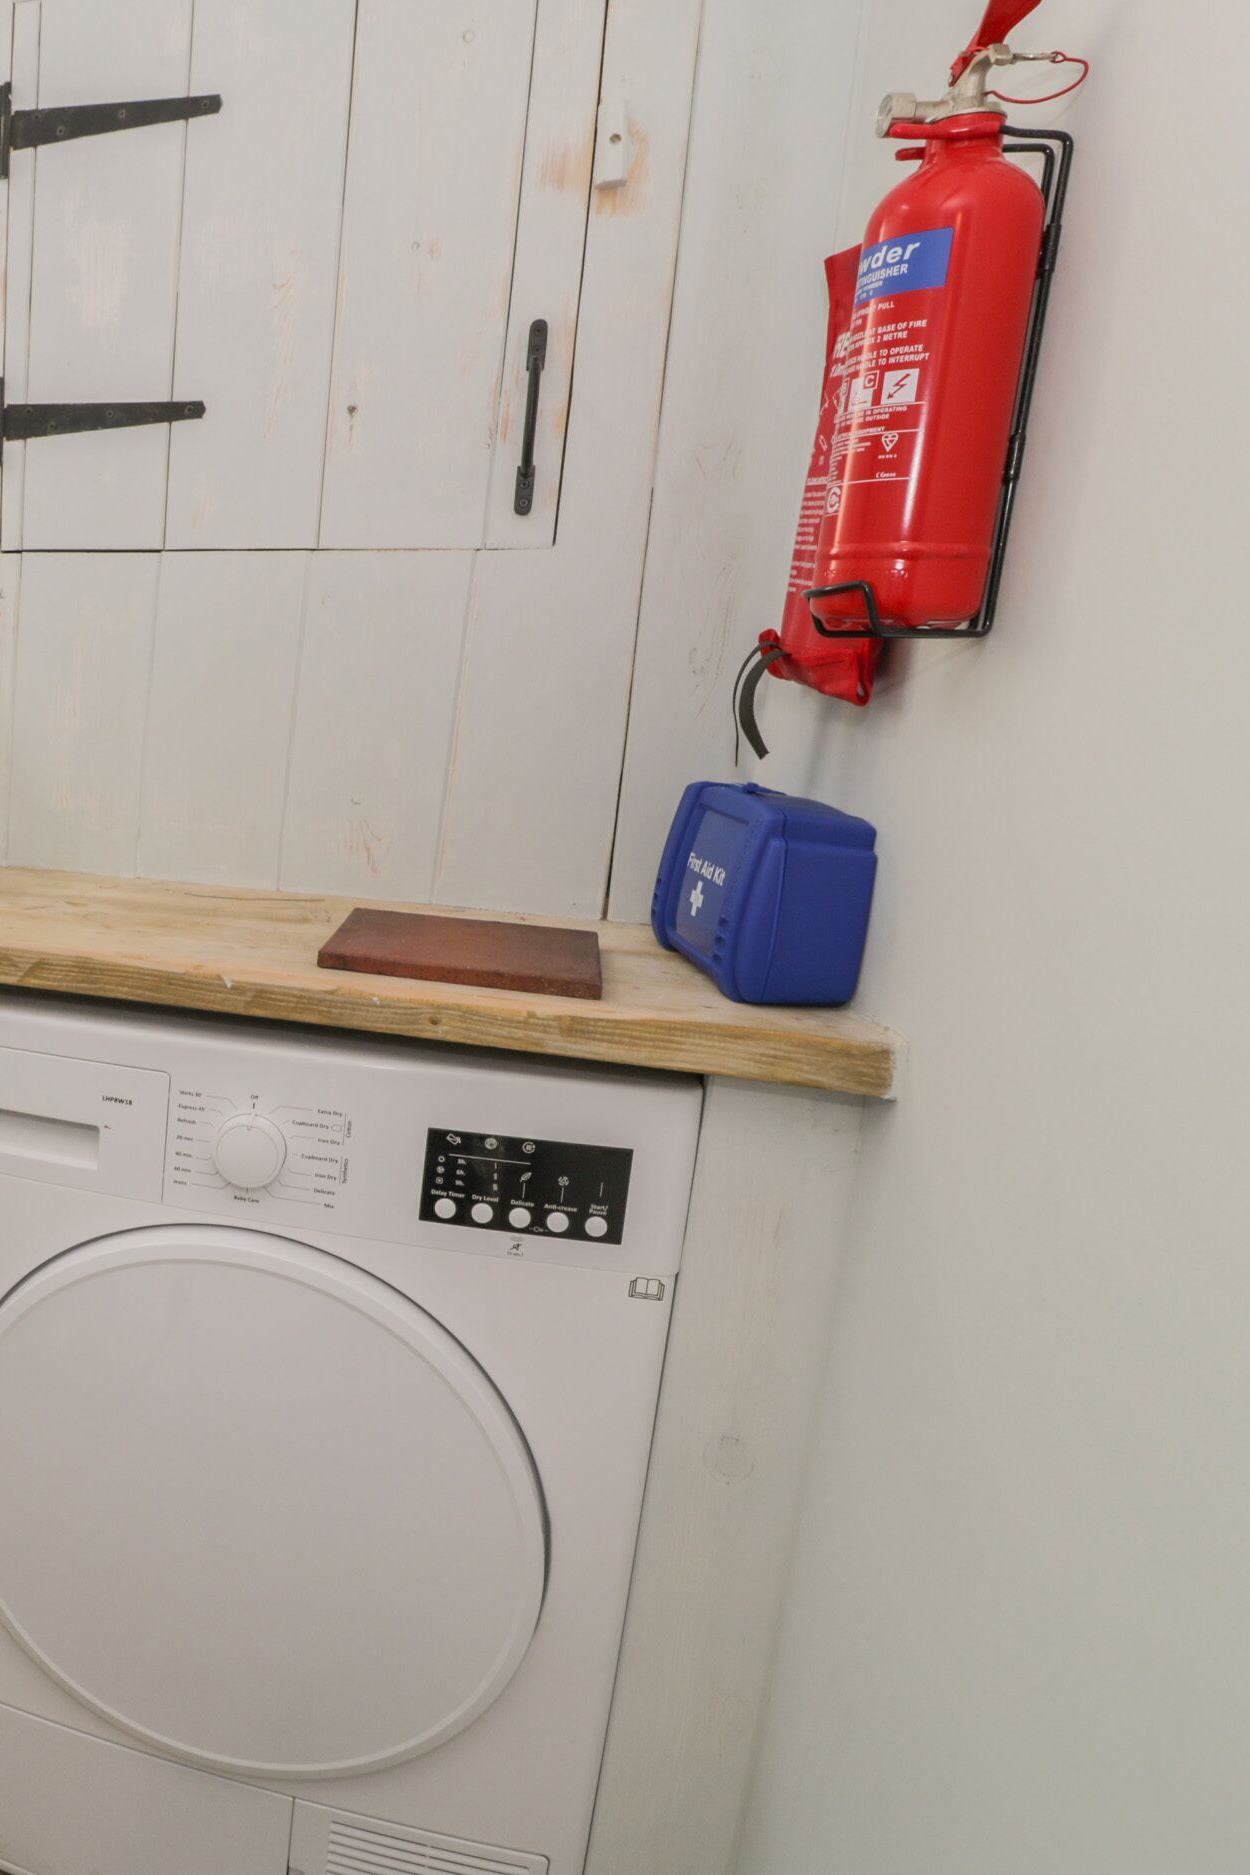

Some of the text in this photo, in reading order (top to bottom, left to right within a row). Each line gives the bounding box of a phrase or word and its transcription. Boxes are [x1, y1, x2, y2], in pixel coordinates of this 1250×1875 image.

[877, 301, 895, 311] PULL
[877, 324, 896, 333] BASE
[897, 322, 907, 330] OF
[908, 319, 927, 328] FIRE
[882, 331, 908, 341] METRE
[879, 348, 888, 356] TO
[890, 344, 924, 354] OPERATE
[878, 357, 887, 366] TO
[888, 352, 930, 364] INTERRUPT
[686, 851, 726, 887] First Aid Kit
[317, 1108, 332, 1116] Extra
[292, 1119, 330, 1130] Cupboard Dry
[330, 1138, 341, 1146] Dry
[301, 1152, 339, 1164] Cupboard Dry
[327, 1173, 338, 1181] Dry
[313, 1187, 336, 1196] Delicate
[431, 1188, 466, 1199] Delay Timer
[233, 1194, 260, 1204] Baby Care
[471, 1193, 499, 1204] Dry Level
[510, 1199, 535, 1208] Delicate
[543, 1203, 578, 1213] Anti-crease
[590, 1203, 609, 1211] Start/
[589, 1208, 607, 1217] Pause
